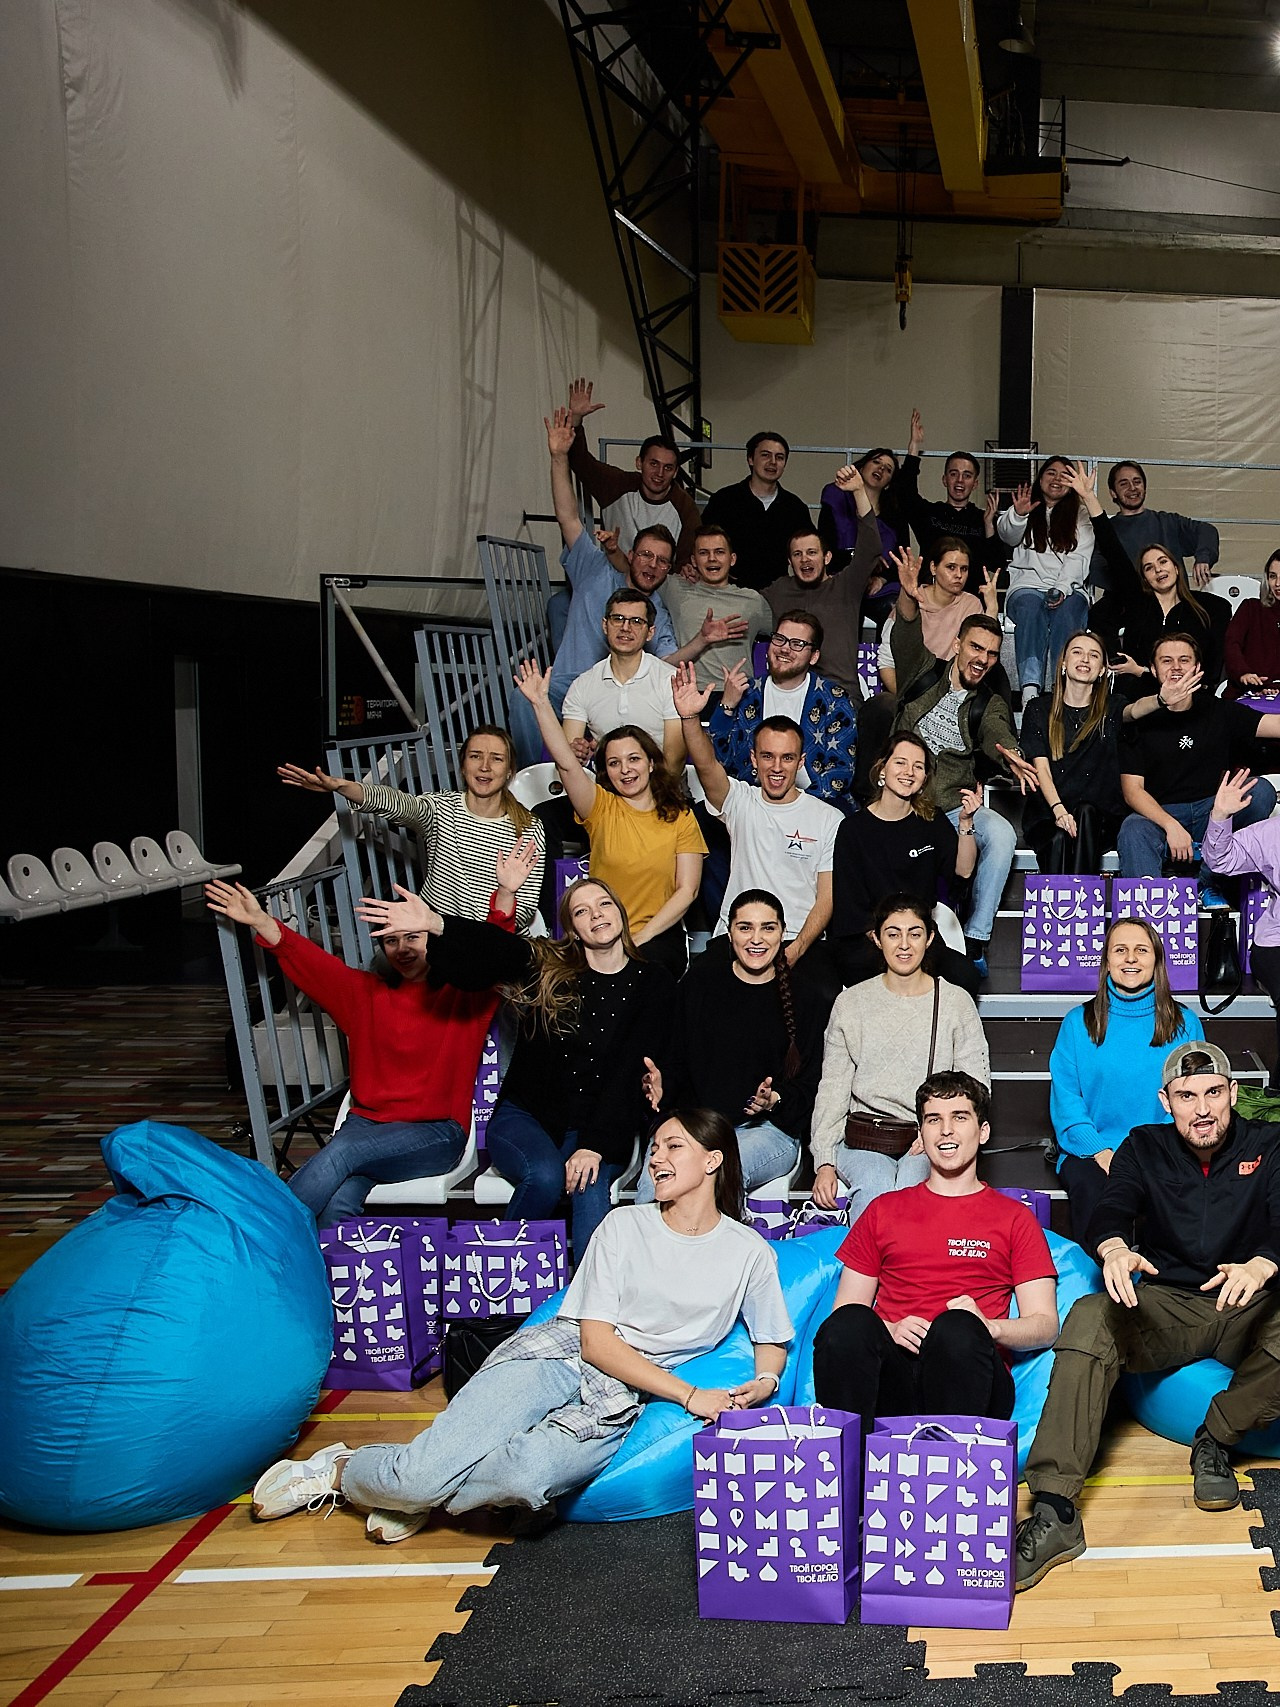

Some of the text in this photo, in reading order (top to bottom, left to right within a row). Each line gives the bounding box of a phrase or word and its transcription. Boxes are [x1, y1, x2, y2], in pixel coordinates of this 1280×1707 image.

[947, 1238, 991, 1250] ТВОЙ ГОРОД
[948, 1248, 987, 1258] ТВОЁ ДЕЛО
[364, 1345, 405, 1356] ТВОЙ ГОРОД
[789, 1563, 839, 1574] ТВОЙ ГОРОД
[956, 1567, 1005, 1580] ТВОЙ ГОРОД
[796, 1573, 839, 1583] ТВОЁ ДЕЛО
[962, 1578, 1005, 1589] ТВОЁ ДЕЛО
